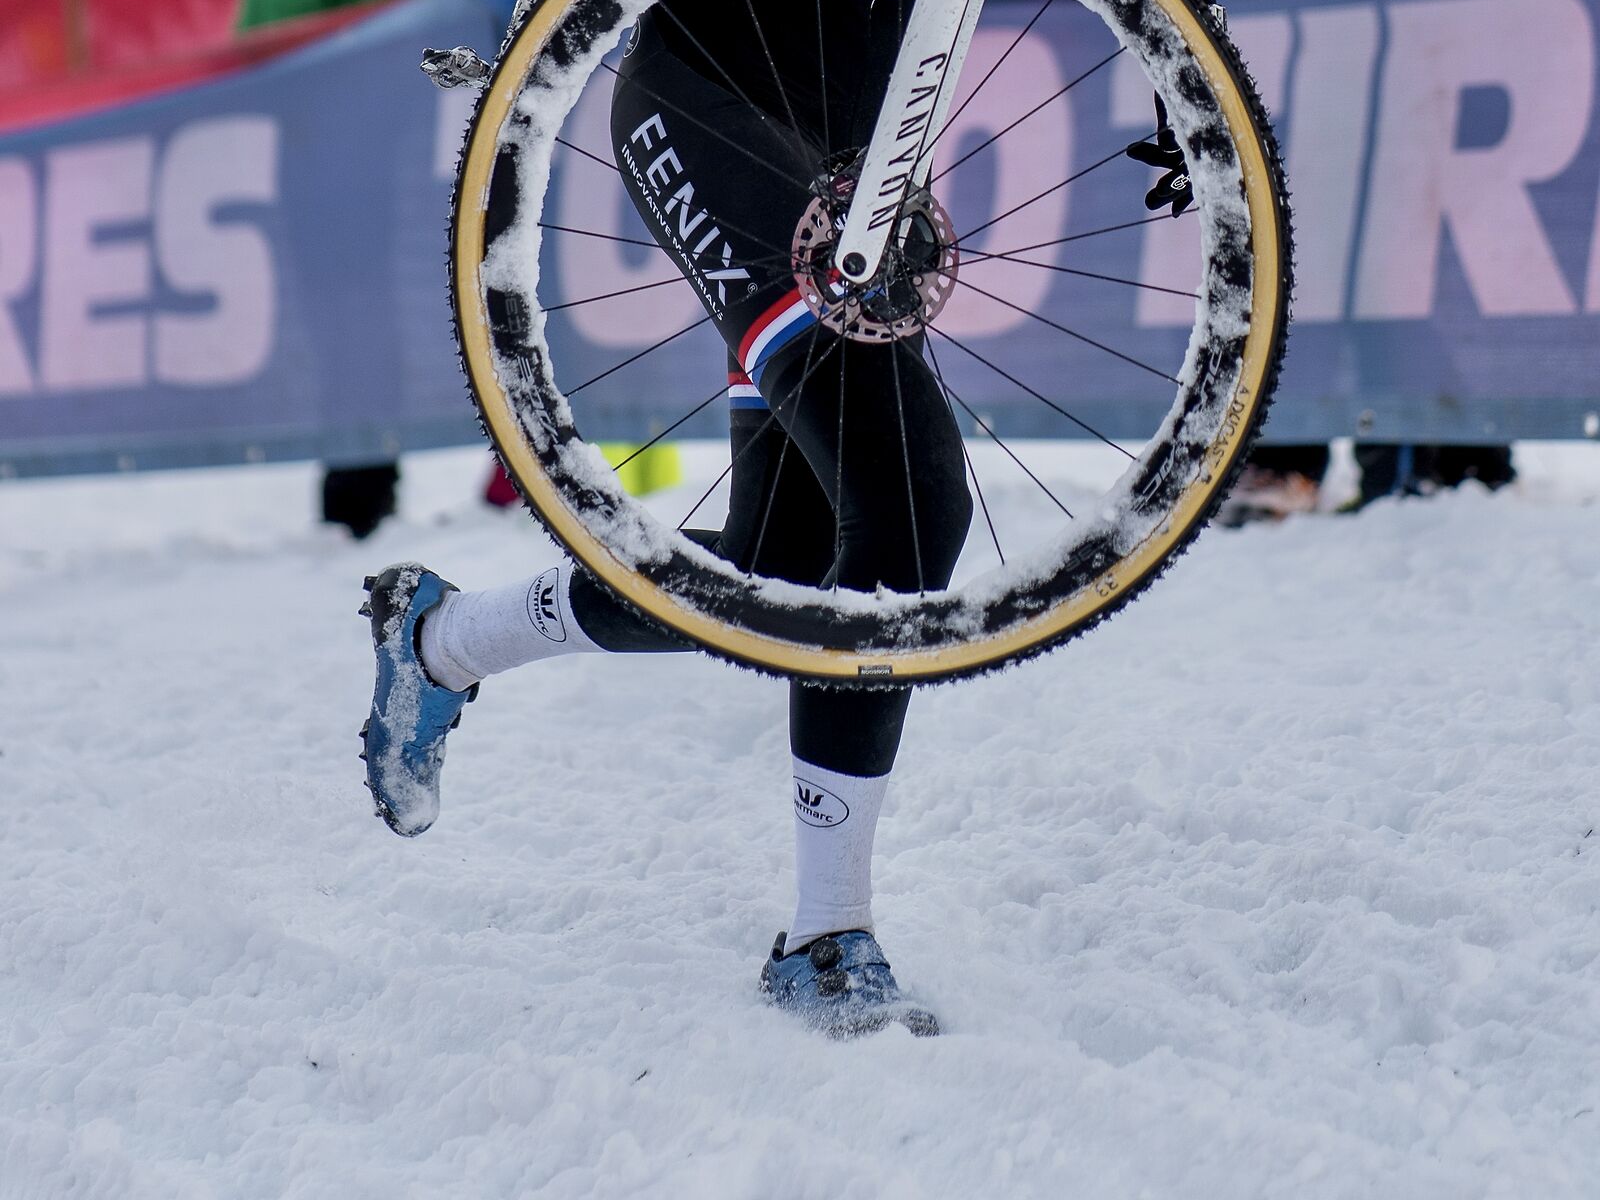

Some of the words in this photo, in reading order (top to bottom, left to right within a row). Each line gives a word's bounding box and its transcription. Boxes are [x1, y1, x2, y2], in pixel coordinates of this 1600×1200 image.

[630, 113, 751, 306] FENIX
[866, 52, 948, 232] CANYON
[621, 143, 672, 239] INNOVATIVE
[673, 239, 725, 322] MATERIALS
[536, 576, 550, 634] vermarc
